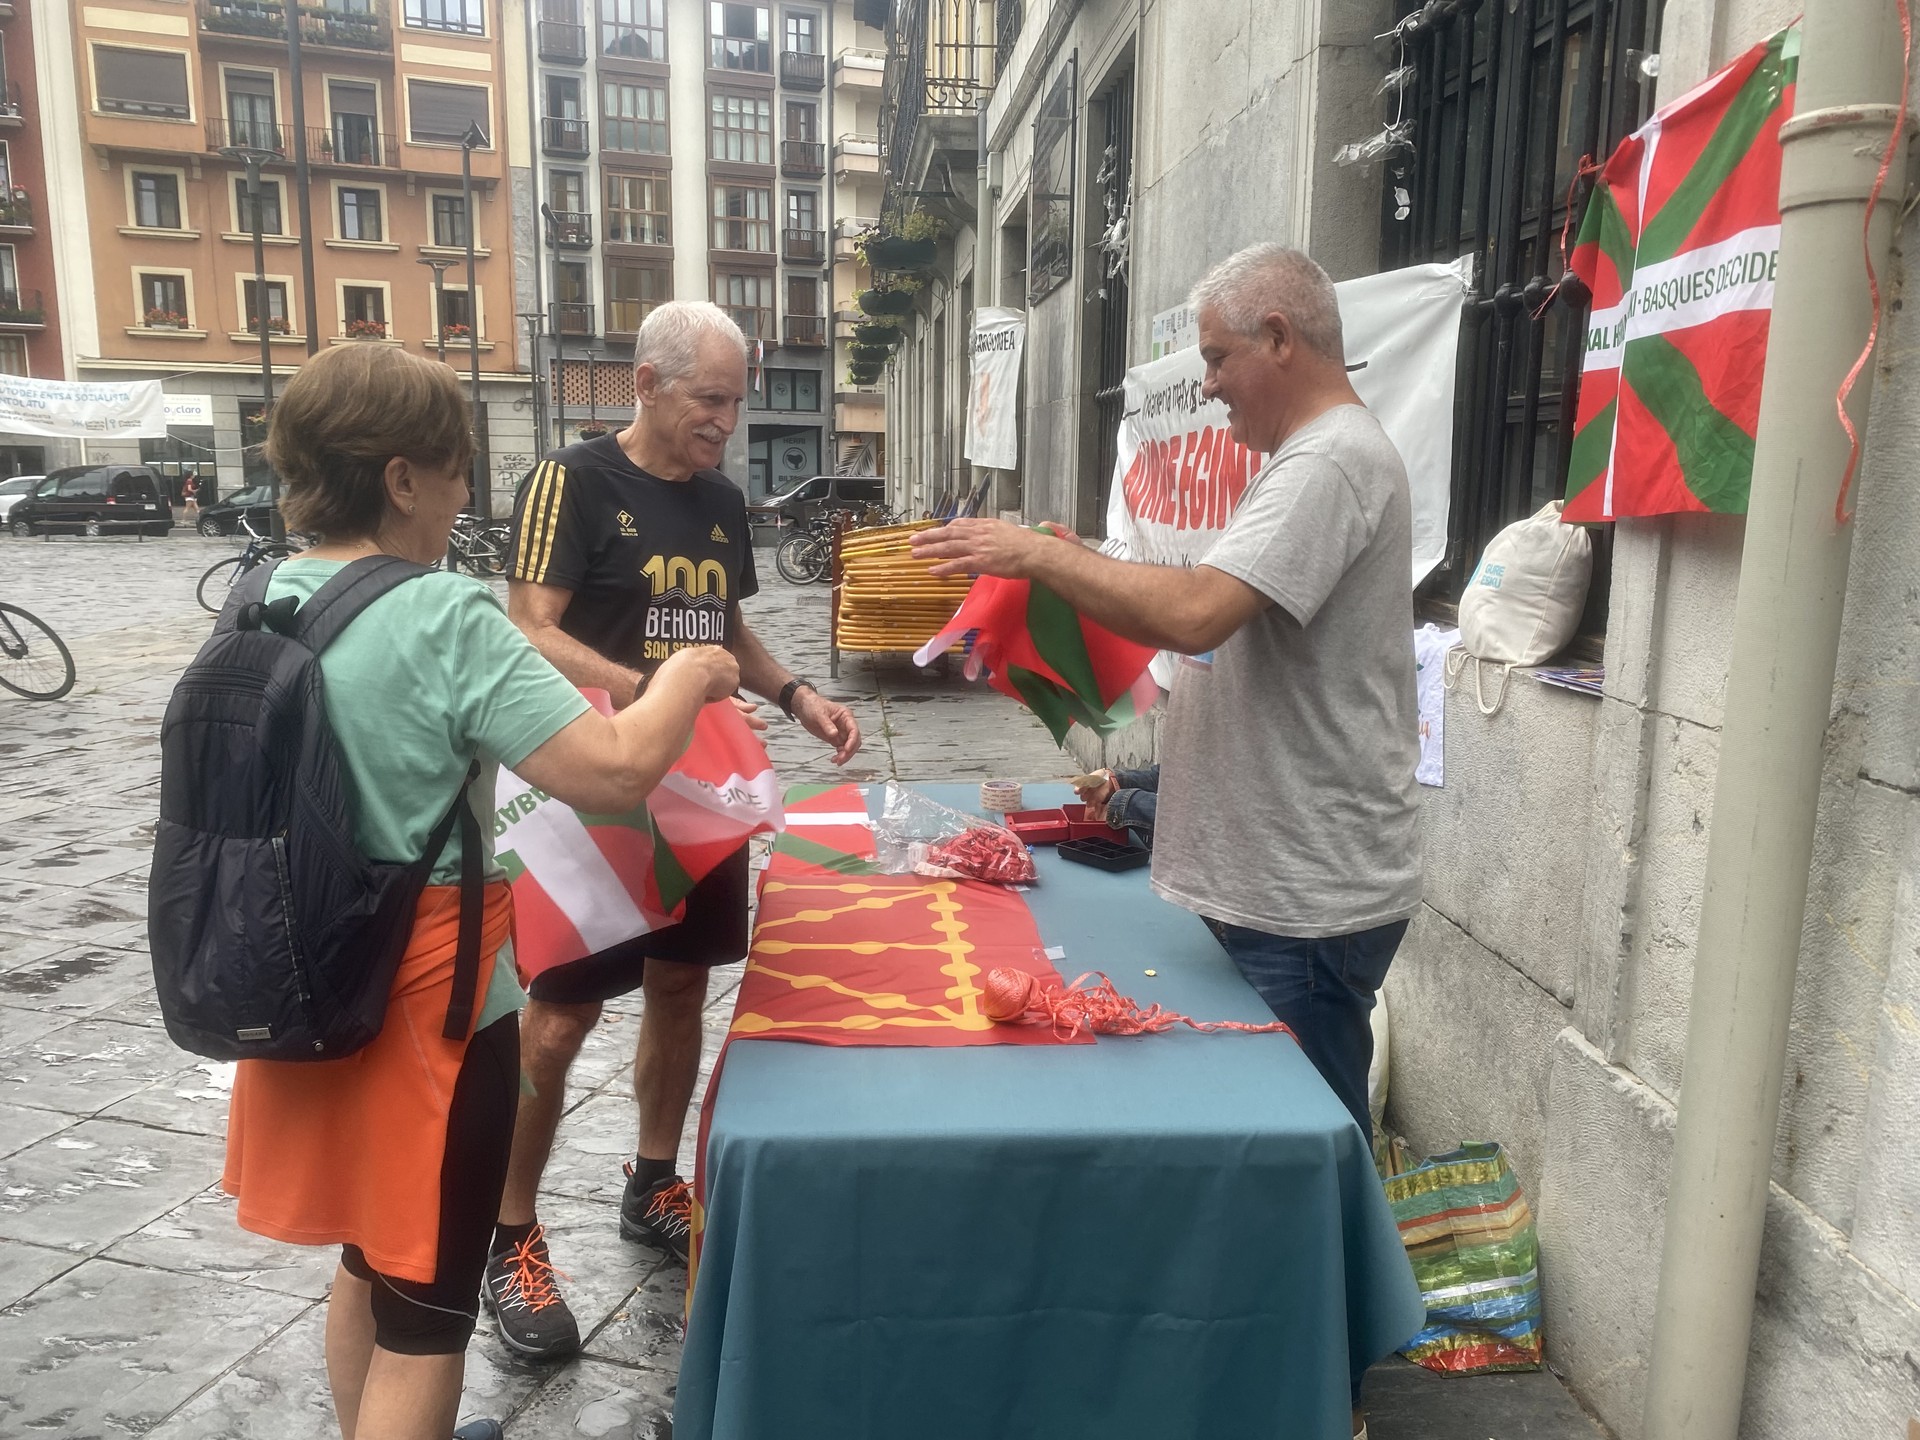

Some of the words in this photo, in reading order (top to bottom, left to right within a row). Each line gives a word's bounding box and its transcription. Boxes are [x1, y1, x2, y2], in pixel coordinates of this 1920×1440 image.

[1642, 267, 1715, 314] BASQUES
[1715, 250, 1778, 294] DECIDE
[75, 391, 130, 402] SOZIALISTA
[640, 554, 727, 601] 100
[1484, 563, 1506, 577] GURE
[1480, 574, 1502, 589] ESKU
[645, 606, 725, 641] BEHOBIA
[643, 640, 669, 660] SAN
